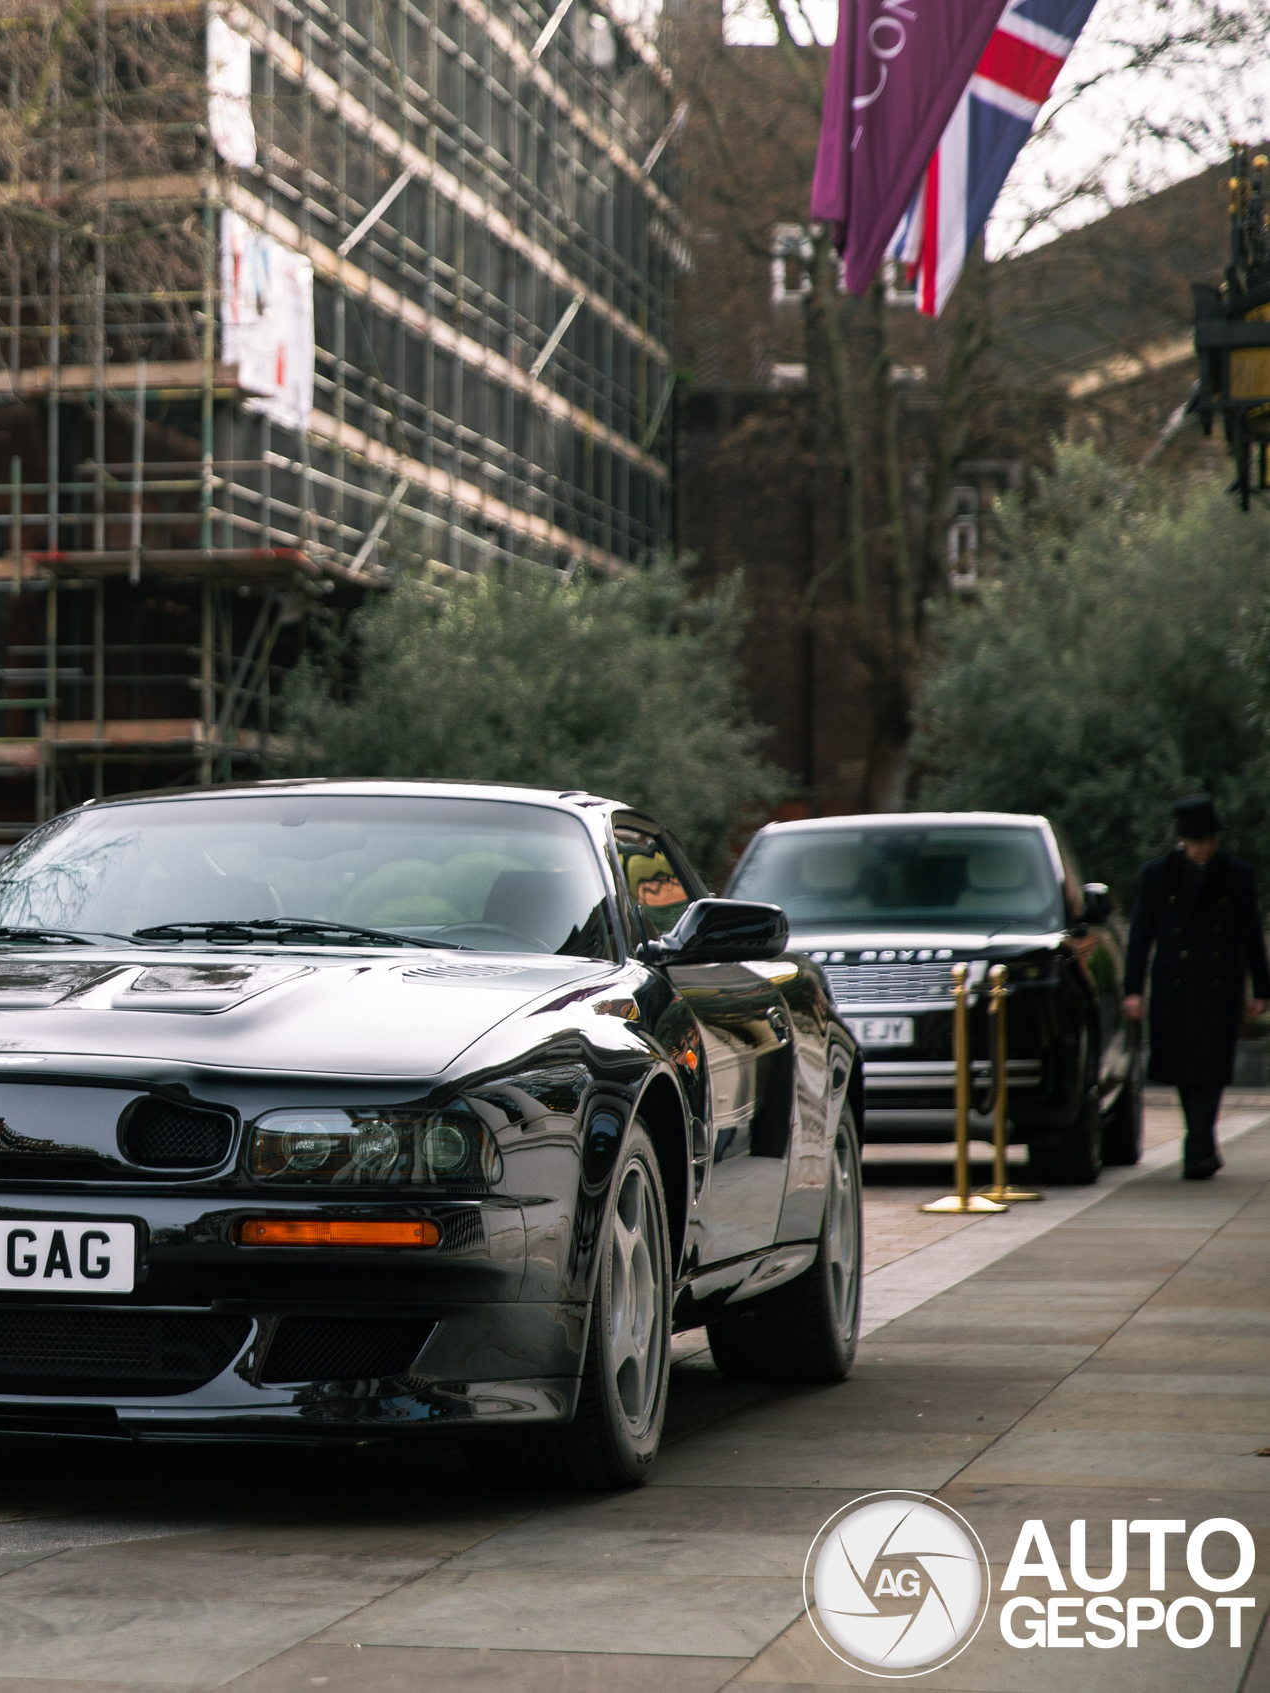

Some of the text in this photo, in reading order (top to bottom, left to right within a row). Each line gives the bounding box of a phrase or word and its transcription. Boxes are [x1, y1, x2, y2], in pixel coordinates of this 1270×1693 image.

[859, 949, 953, 962] ROVER
[862, 1020, 904, 1040] EJY
[7, 1227, 111, 1279] GAG
